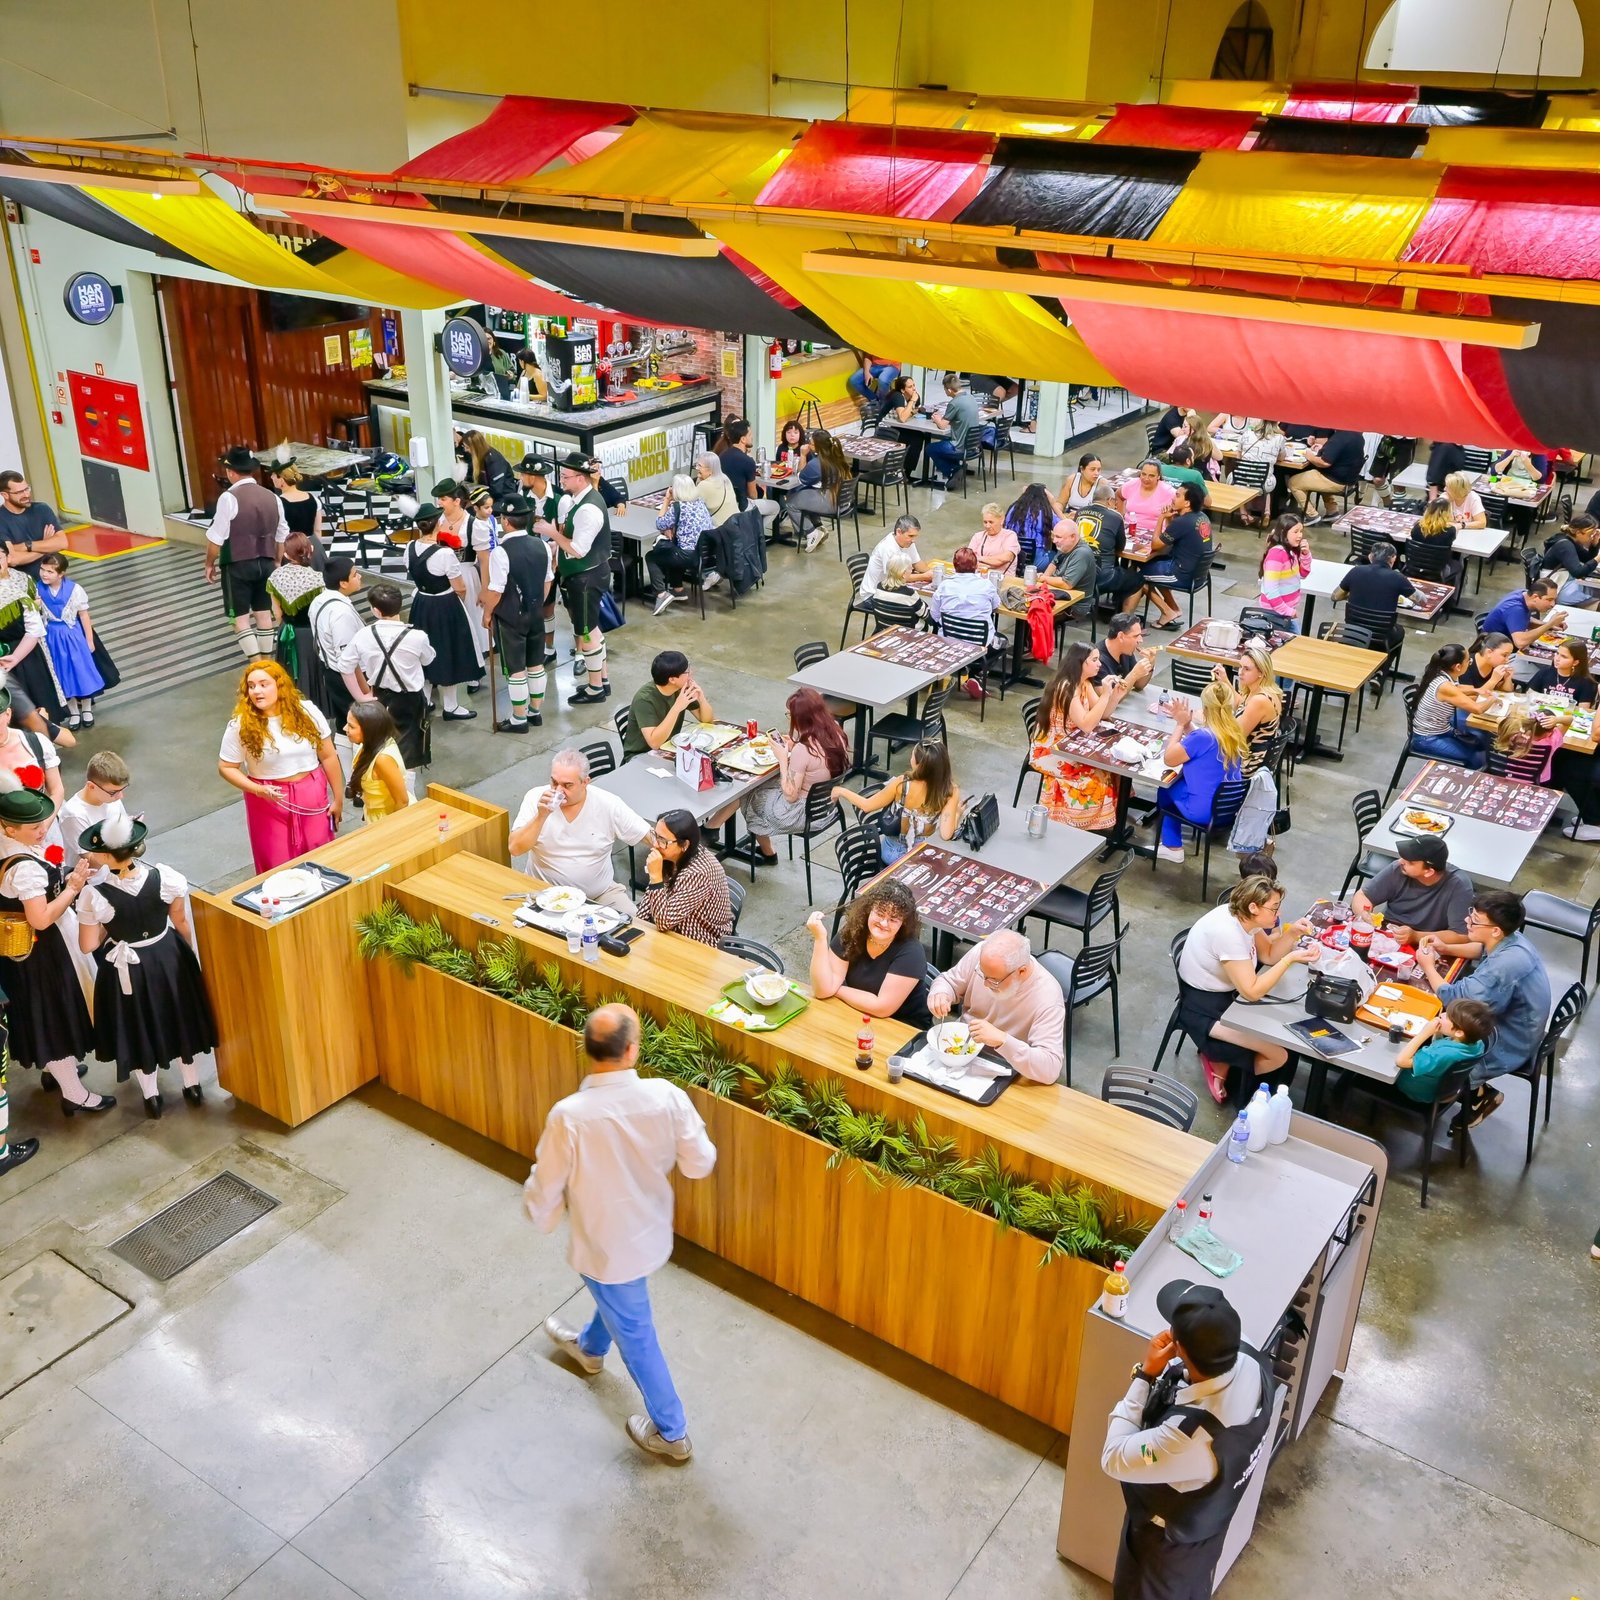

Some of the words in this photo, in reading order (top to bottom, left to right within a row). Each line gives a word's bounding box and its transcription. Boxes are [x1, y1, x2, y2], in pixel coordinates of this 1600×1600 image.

[78, 283, 102, 296] HAR
[80, 291, 104, 306] DEN
[450, 330, 471, 345] HAR
[451, 342, 472, 356] DEN
[574, 344, 592, 354] HAR
[574, 351, 592, 363] DEN
[639, 431, 667, 455] MUITO
[627, 450, 670, 483] HARDEN
